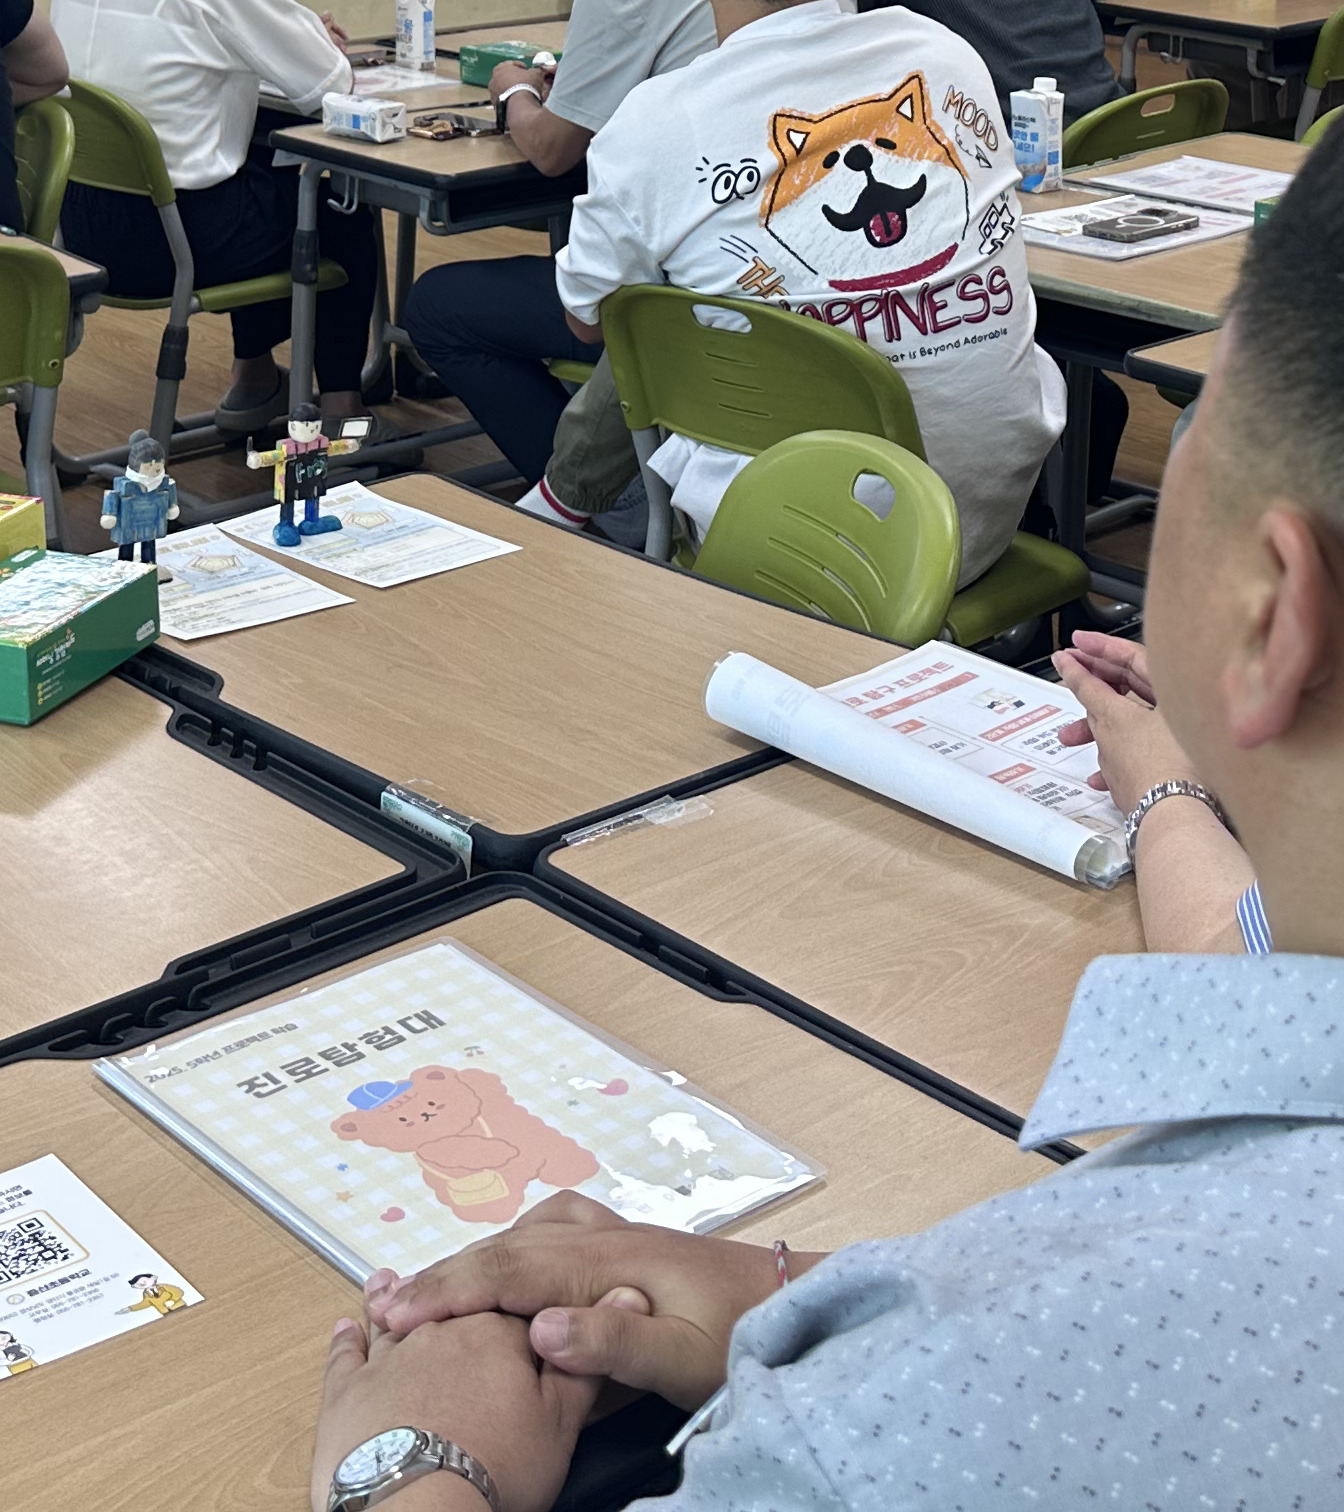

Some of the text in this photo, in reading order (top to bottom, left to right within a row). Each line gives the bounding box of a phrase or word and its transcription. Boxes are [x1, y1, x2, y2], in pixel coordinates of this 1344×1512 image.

[942, 84, 998, 152] MOOD
[920, 339, 961, 359] Beyond
[963, 327, 1009, 346] Adorable
[189, 1049, 223, 1069] 5학년
[223, 1030, 274, 1055] 프로젝트
[270, 1022, 299, 1036] 학습
[236, 1009, 447, 1098] 진로탐험대
